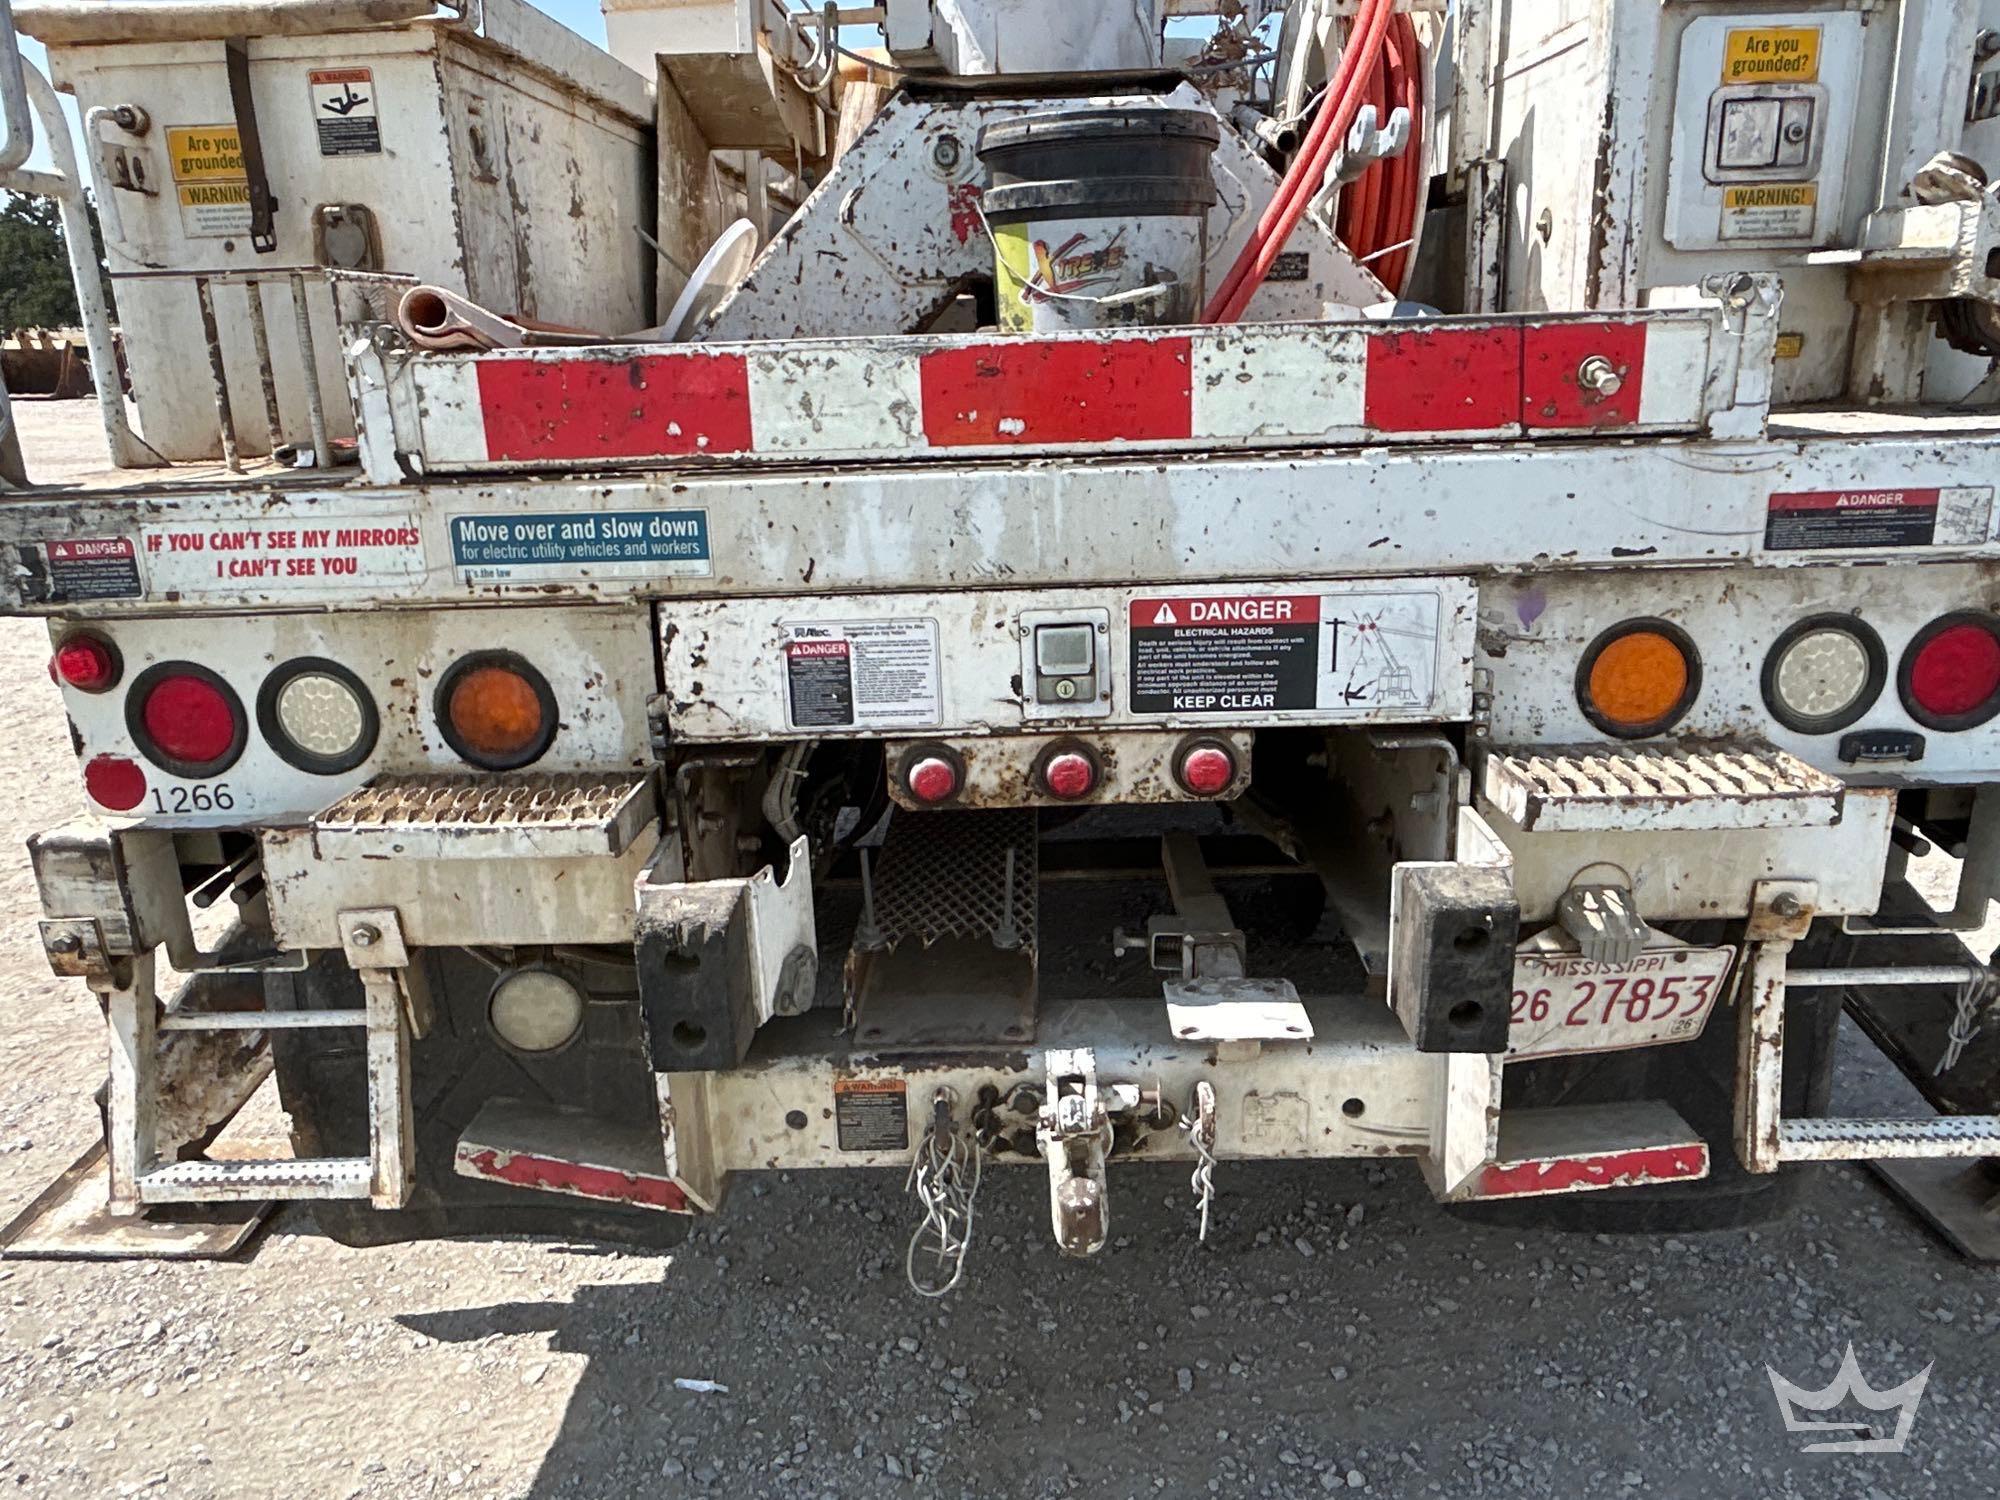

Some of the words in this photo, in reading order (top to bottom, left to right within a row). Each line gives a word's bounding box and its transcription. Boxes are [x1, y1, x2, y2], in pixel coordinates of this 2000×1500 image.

[1746, 36, 1769, 53] Are
[1774, 39, 1799, 56] you
[1732, 55, 1808, 76] grounded?
[188, 136, 210, 151] Are
[214, 138, 237, 153] you
[1735, 189, 1805, 205] WARNING!
[1851, 494, 1903, 505] DANGER
[460, 521, 509, 542] Move
[515, 522, 555, 540] over
[561, 519, 595, 540] and
[602, 518, 643, 538] slow
[650, 516, 698, 537] down
[147, 534, 162, 551] IF
[168, 534, 203, 550] YOU
[210, 532, 261, 550] CAN'T
[267, 532, 296, 549] SEE
[303, 530, 330, 548] MY
[336, 528, 419, 547] MIRRORS
[75, 543, 126, 555] DANGER
[461, 546, 479, 559] for
[483, 544, 528, 559] electric
[532, 543, 566, 560] utility
[570, 542, 620, 557] vehicles
[624, 541, 647, 556] and
[651, 540, 700, 555] workers
[218, 561, 222, 577] I
[229, 559, 280, 577] CAN'T
[287, 558, 315, 575] SEE
[322, 557, 357, 574] YOU
[480, 570, 494, 578] the
[497, 569, 510, 577] law
[1190, 601, 1292, 621] DANGER
[1174, 629, 1228, 637] ELECTRICAL
[1231, 627, 1273, 635] HAZARDS
[802, 644, 846, 655] DANGER
[1174, 696, 1216, 708] KEEP
[1220, 695, 1274, 707] CLEAR
[152, 784, 234, 814] 1266
[1510, 989, 1551, 1024] 26
[1565, 975, 1716, 1025] 27853
[1676, 1019, 1692, 1029] 26
